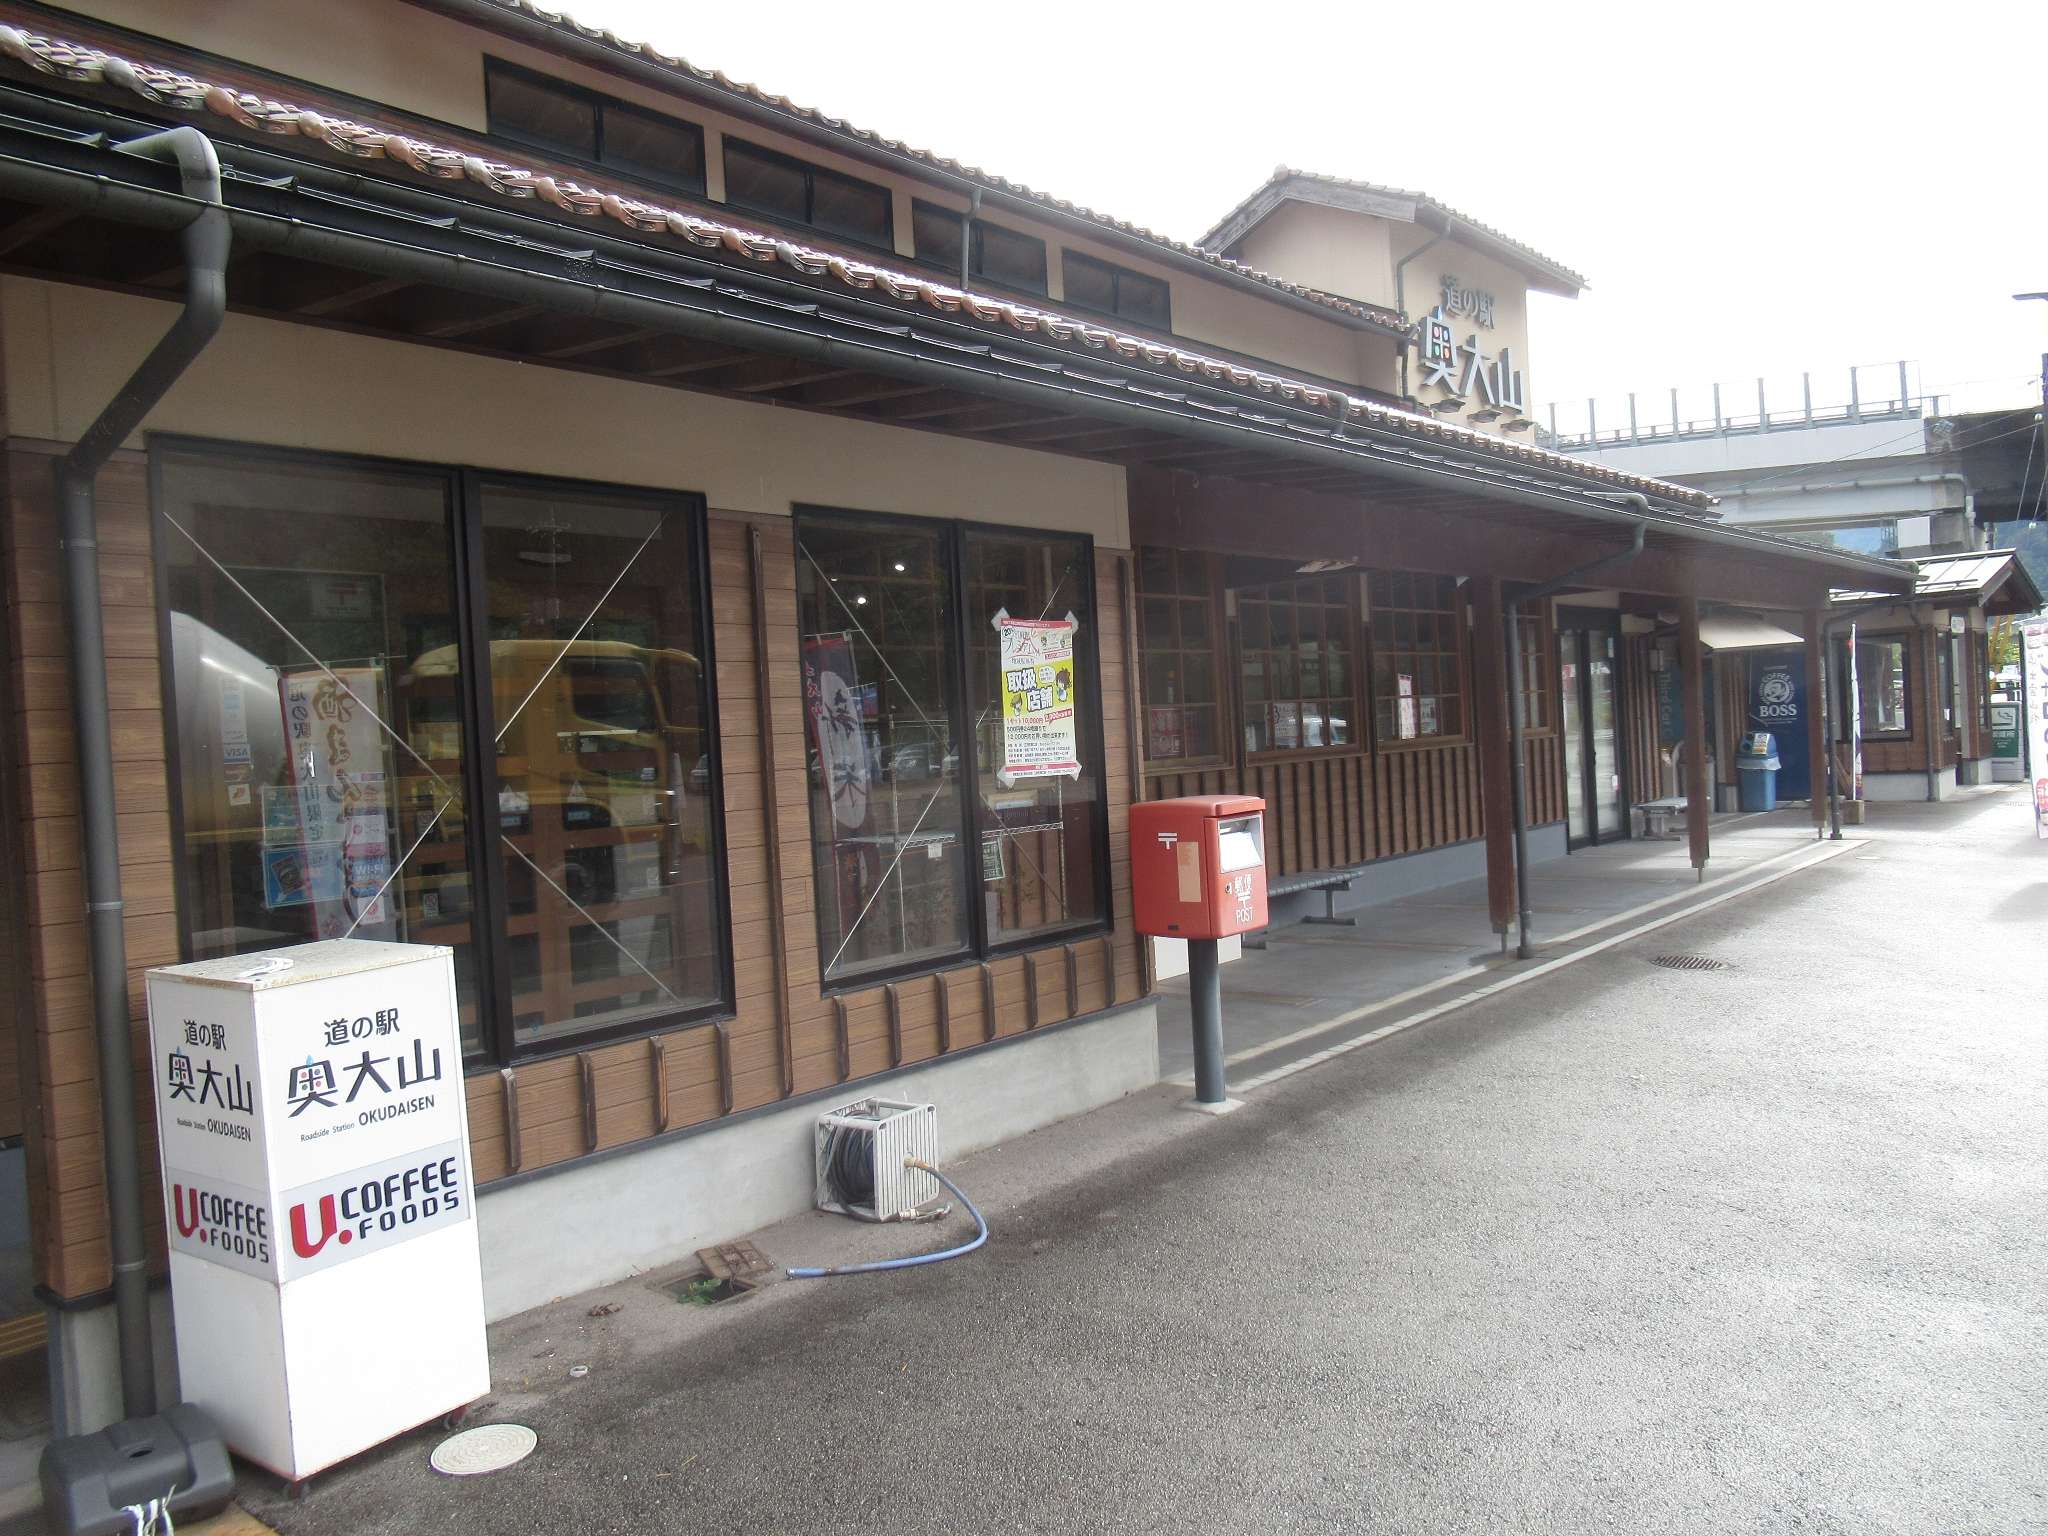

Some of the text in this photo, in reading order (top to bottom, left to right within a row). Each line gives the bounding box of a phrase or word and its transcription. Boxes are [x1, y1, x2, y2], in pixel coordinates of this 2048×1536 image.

[1440, 274, 1494, 329] 道の駅
[1421, 306, 1525, 414] 奥大山
[1759, 704, 1797, 717] BOSS
[226, 748, 249, 758] VISA
[1236, 907, 1253, 925] POST
[184, 1019, 226, 1051] 道の駅
[324, 1008, 400, 1047] 道の駅
[169, 1047, 253, 1115] 奥大山
[287, 1038, 441, 1118] 奥大山
[207, 1118, 251, 1142] OKUDAISEN
[300, 1095, 435, 1142] Roadside Station OKUDAISEN
[341, 1157, 457, 1219] COFFEE
[200, 1192, 267, 1240] COFFEE
[359, 1190, 459, 1239] FOODS
[210, 1228, 269, 1263] FOODS
